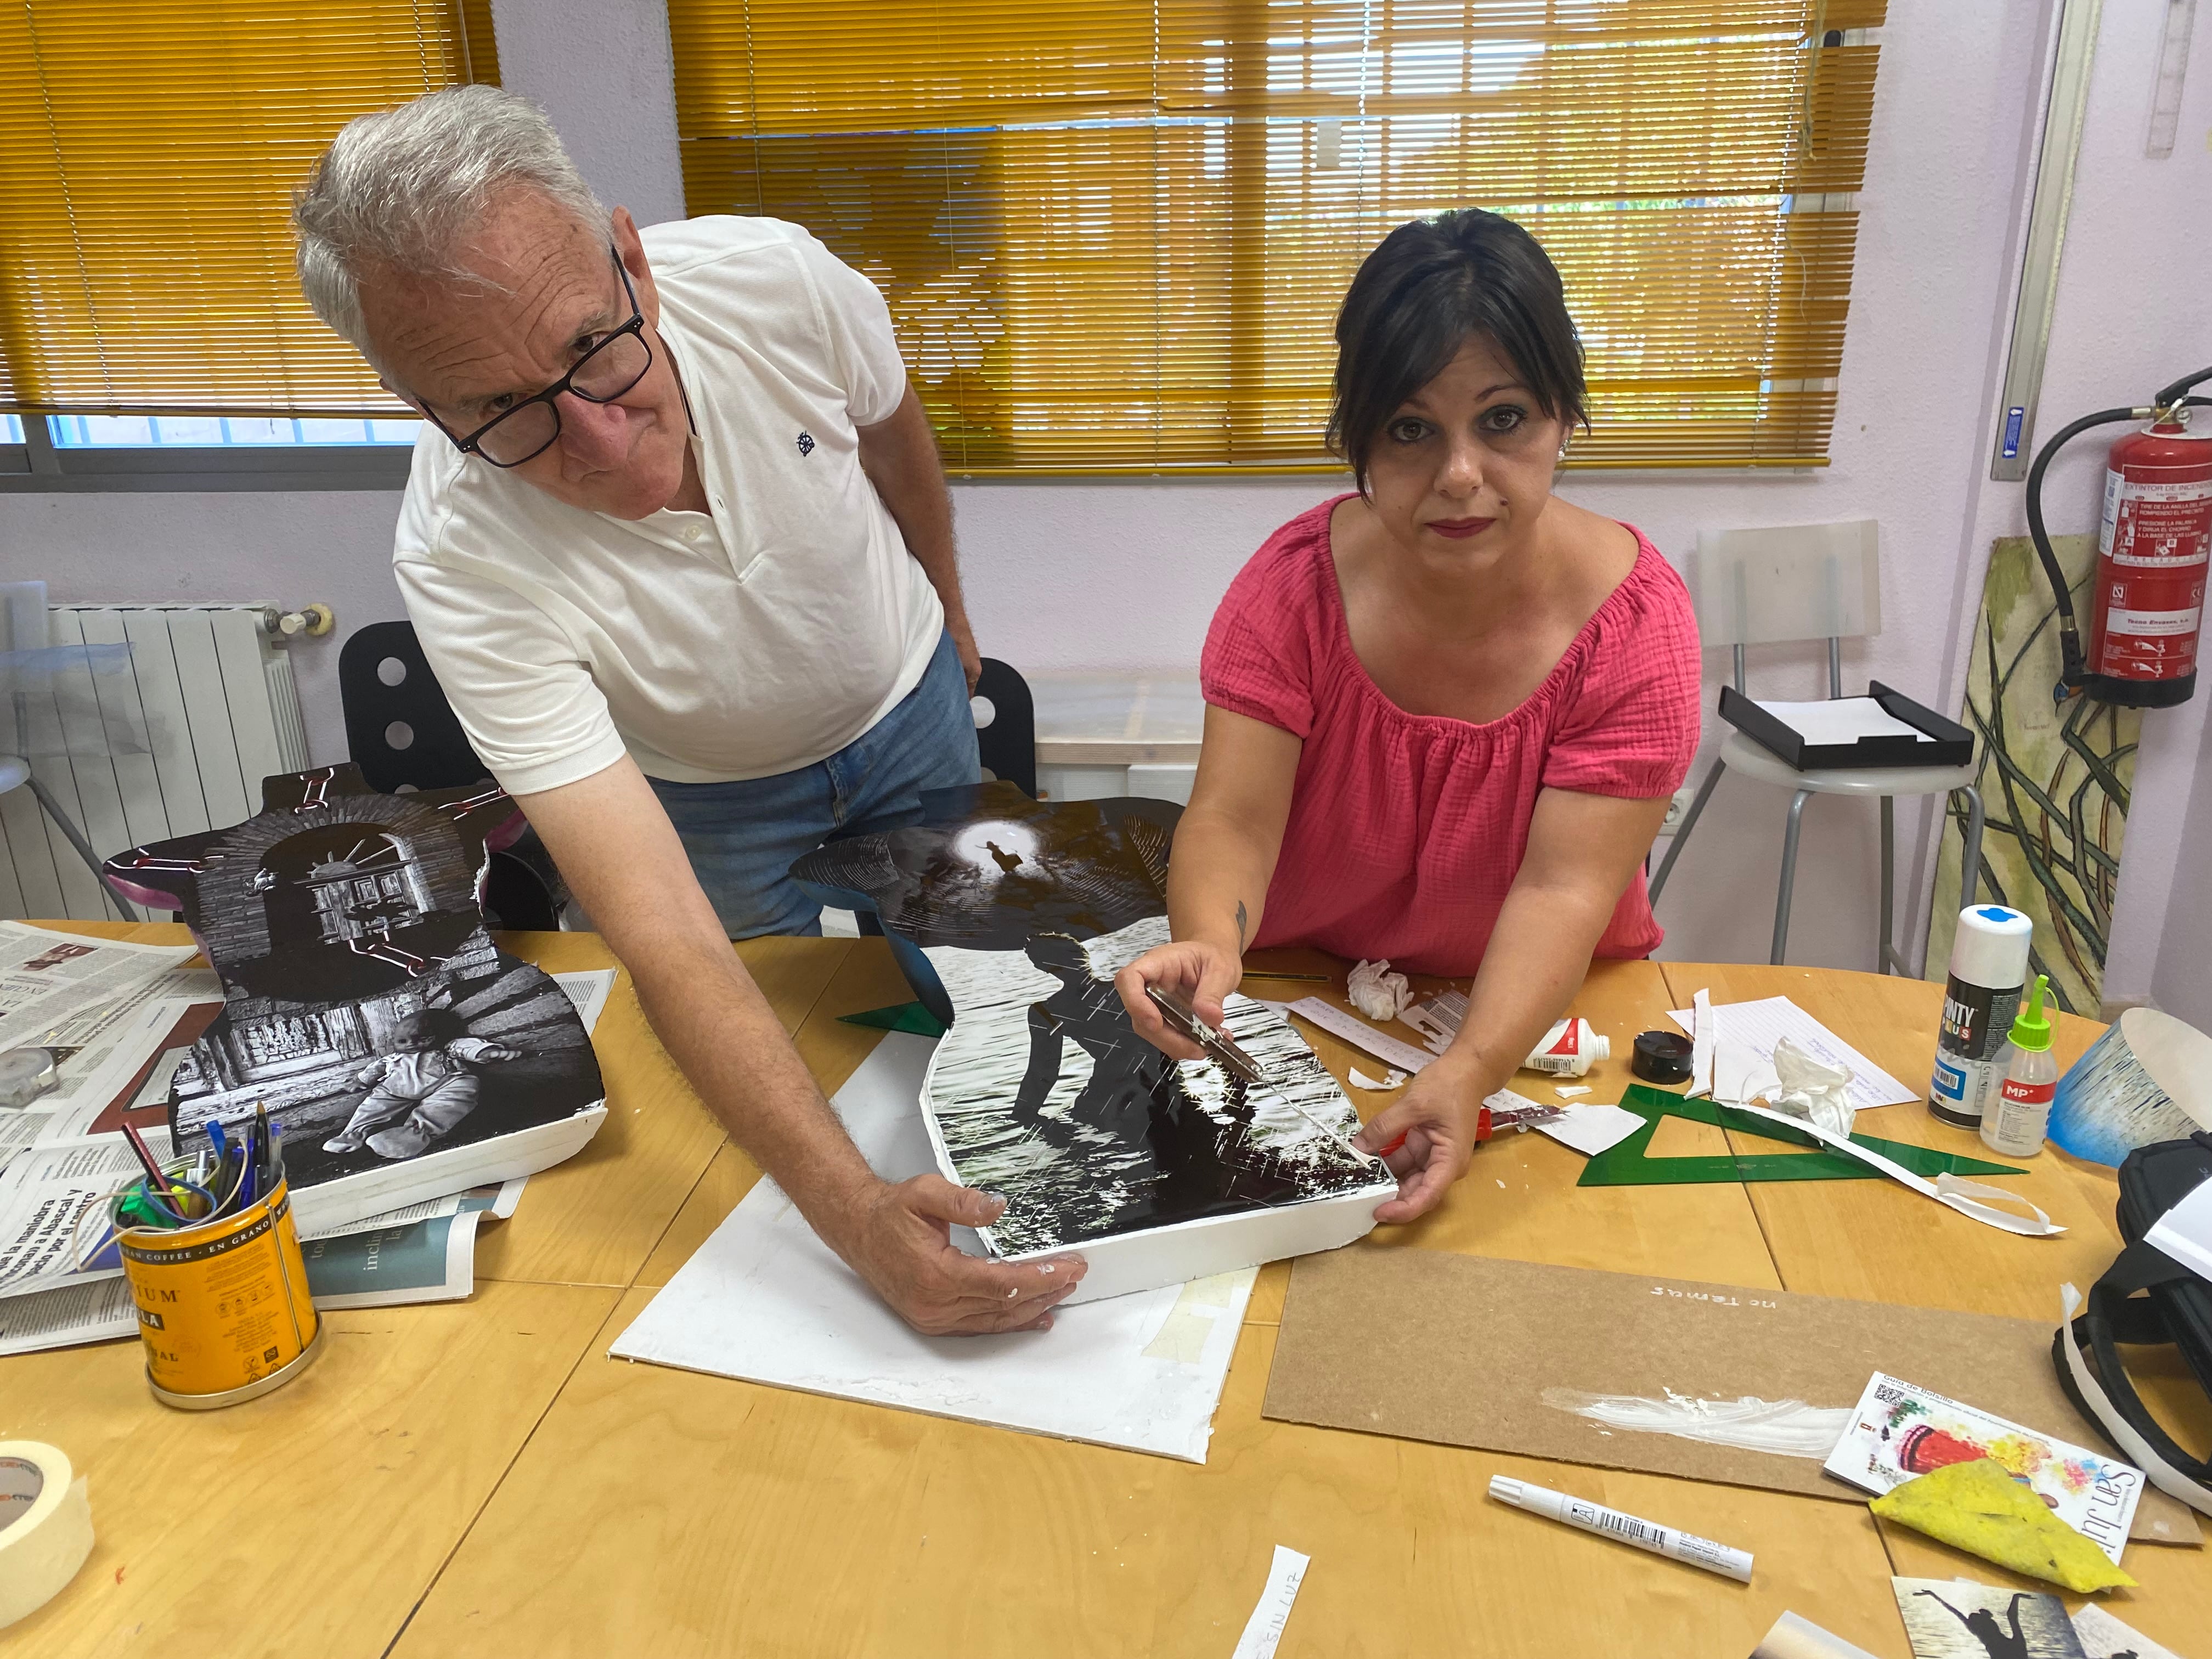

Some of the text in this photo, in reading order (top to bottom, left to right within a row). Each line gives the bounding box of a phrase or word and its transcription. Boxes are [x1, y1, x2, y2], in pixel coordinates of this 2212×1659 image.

[3, 1245, 23, 1255] la
[15, 1199, 57, 1244] maniobra
[38, 1197, 76, 1236] Abascal
[47, 1238, 66, 1252] por
[61, 1228, 75, 1236] el
[146, 1251, 192, 1261] COFFEE
[209, 1243, 225, 1254] EN
[231, 1220, 269, 1245] GRANO
[1921, 1387, 1954, 1404] Bolsillo
[2091, 1464, 2136, 1506] San
[1266, 1613, 1286, 1643] SIN
